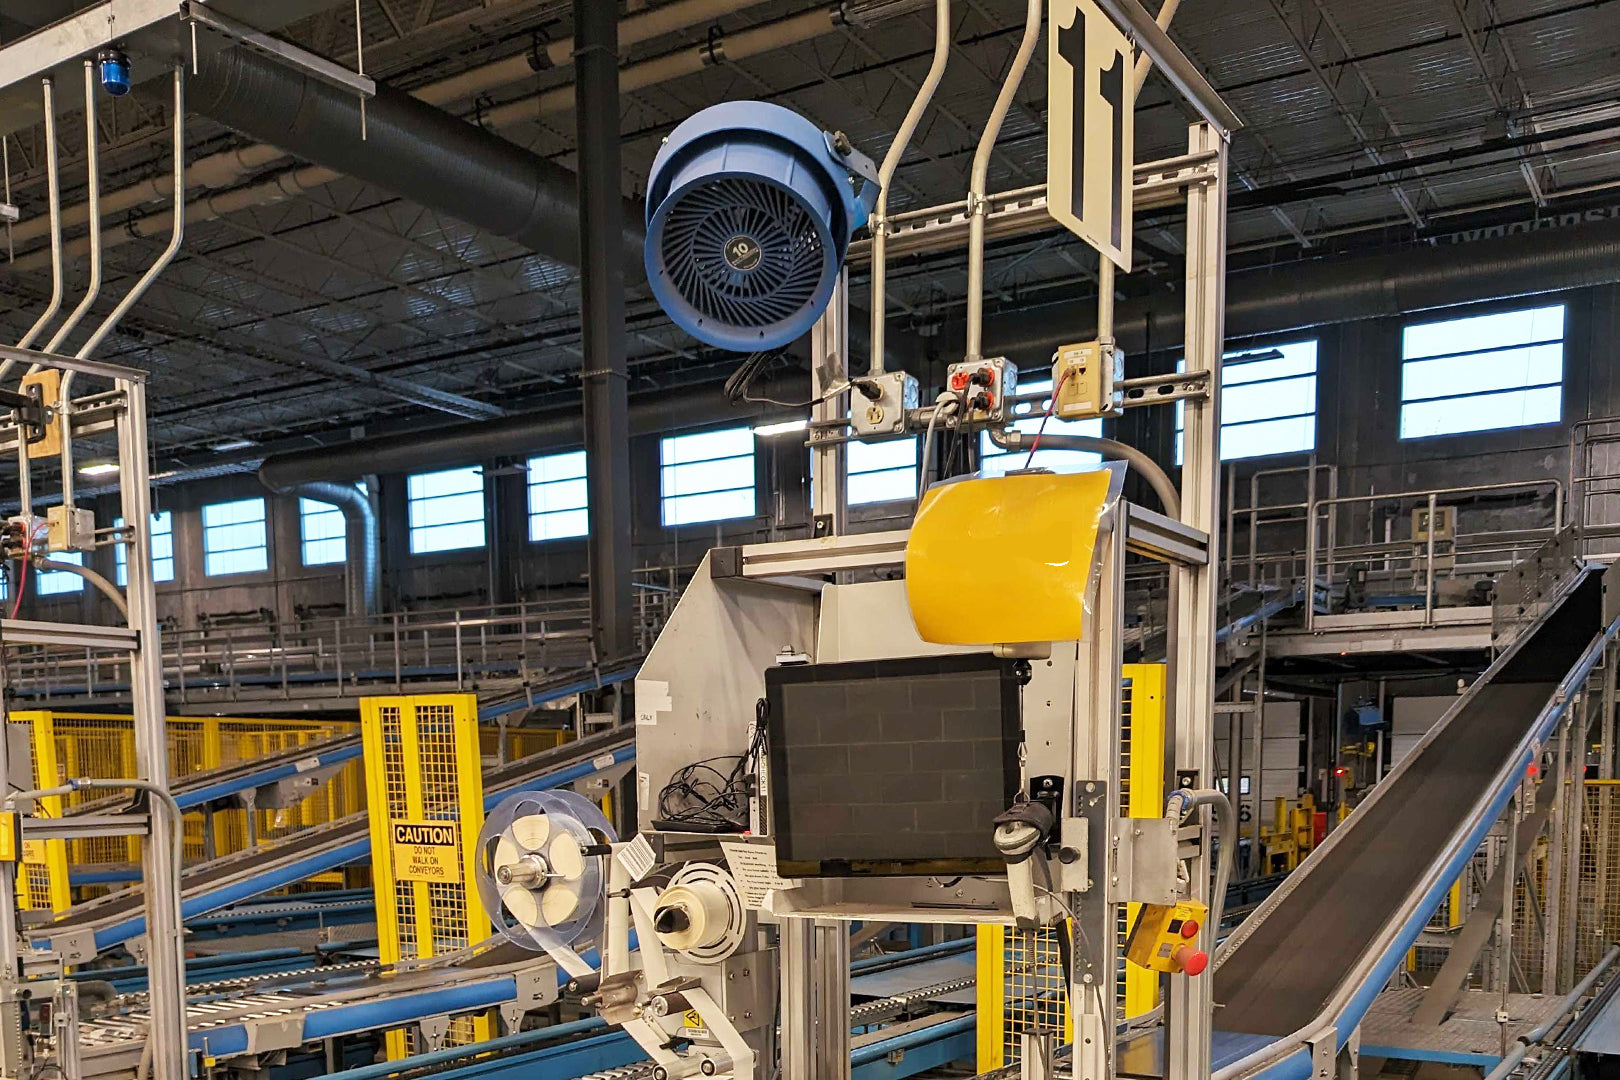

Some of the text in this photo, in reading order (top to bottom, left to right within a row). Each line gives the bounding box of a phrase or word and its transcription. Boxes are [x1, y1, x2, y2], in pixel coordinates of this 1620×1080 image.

[1057, 5, 1124, 253] 11
[732, 242, 749, 257] 10
[396, 826, 453, 843] CAUTION
[414, 846, 435, 855] DO NOT
[412, 856, 439, 865] WALK ON
[408, 865, 444, 875] CONVEYORS
